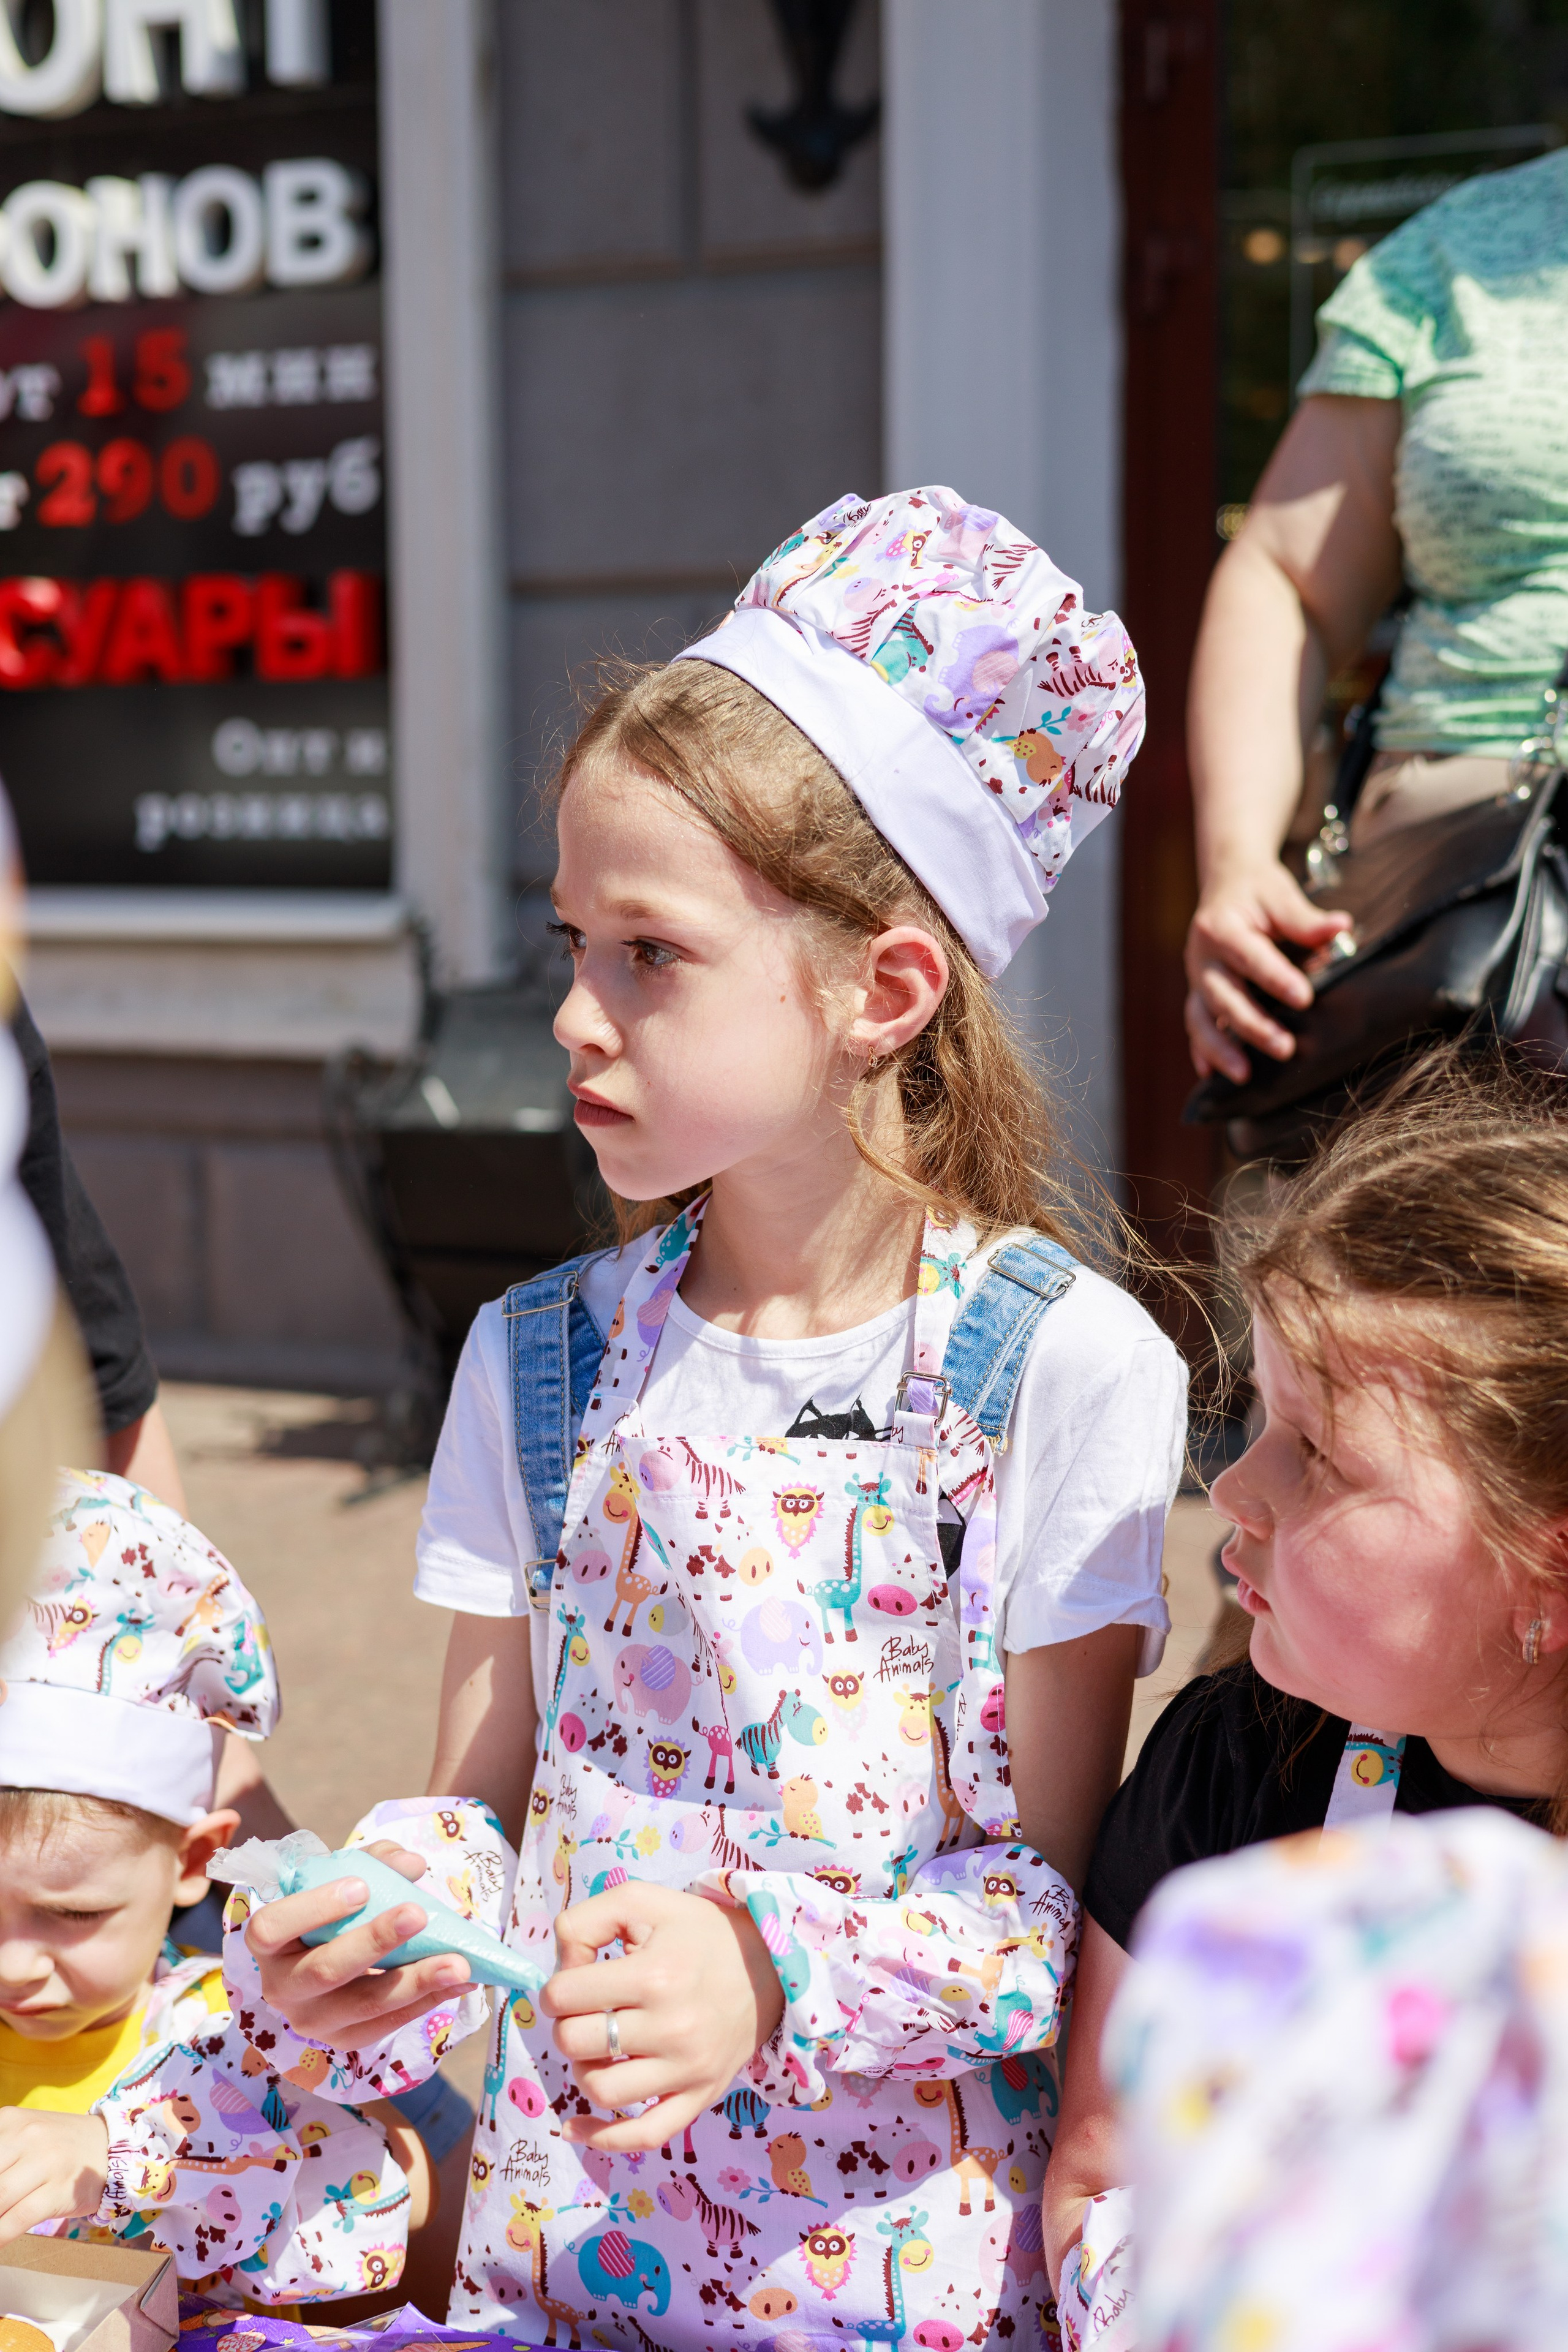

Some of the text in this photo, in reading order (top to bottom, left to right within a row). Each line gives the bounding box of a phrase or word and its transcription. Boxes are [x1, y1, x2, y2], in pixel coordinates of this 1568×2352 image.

[0, 157, 366, 308] ОНОВ
[78, 328, 192, 418] 15
[35, 434, 222, 528] 290
[232, 437, 381, 537] руб
[0, 570, 372, 691] СУАРЫ
[873, 1655, 935, 1683] Animals
[881, 1634, 929, 1660] Baby
[479, 1850, 505, 1894] Baby
[499, 2154, 551, 2187] Animals
[510, 2137, 548, 2169] Baby
[1093, 2288, 1136, 2332] Baby
